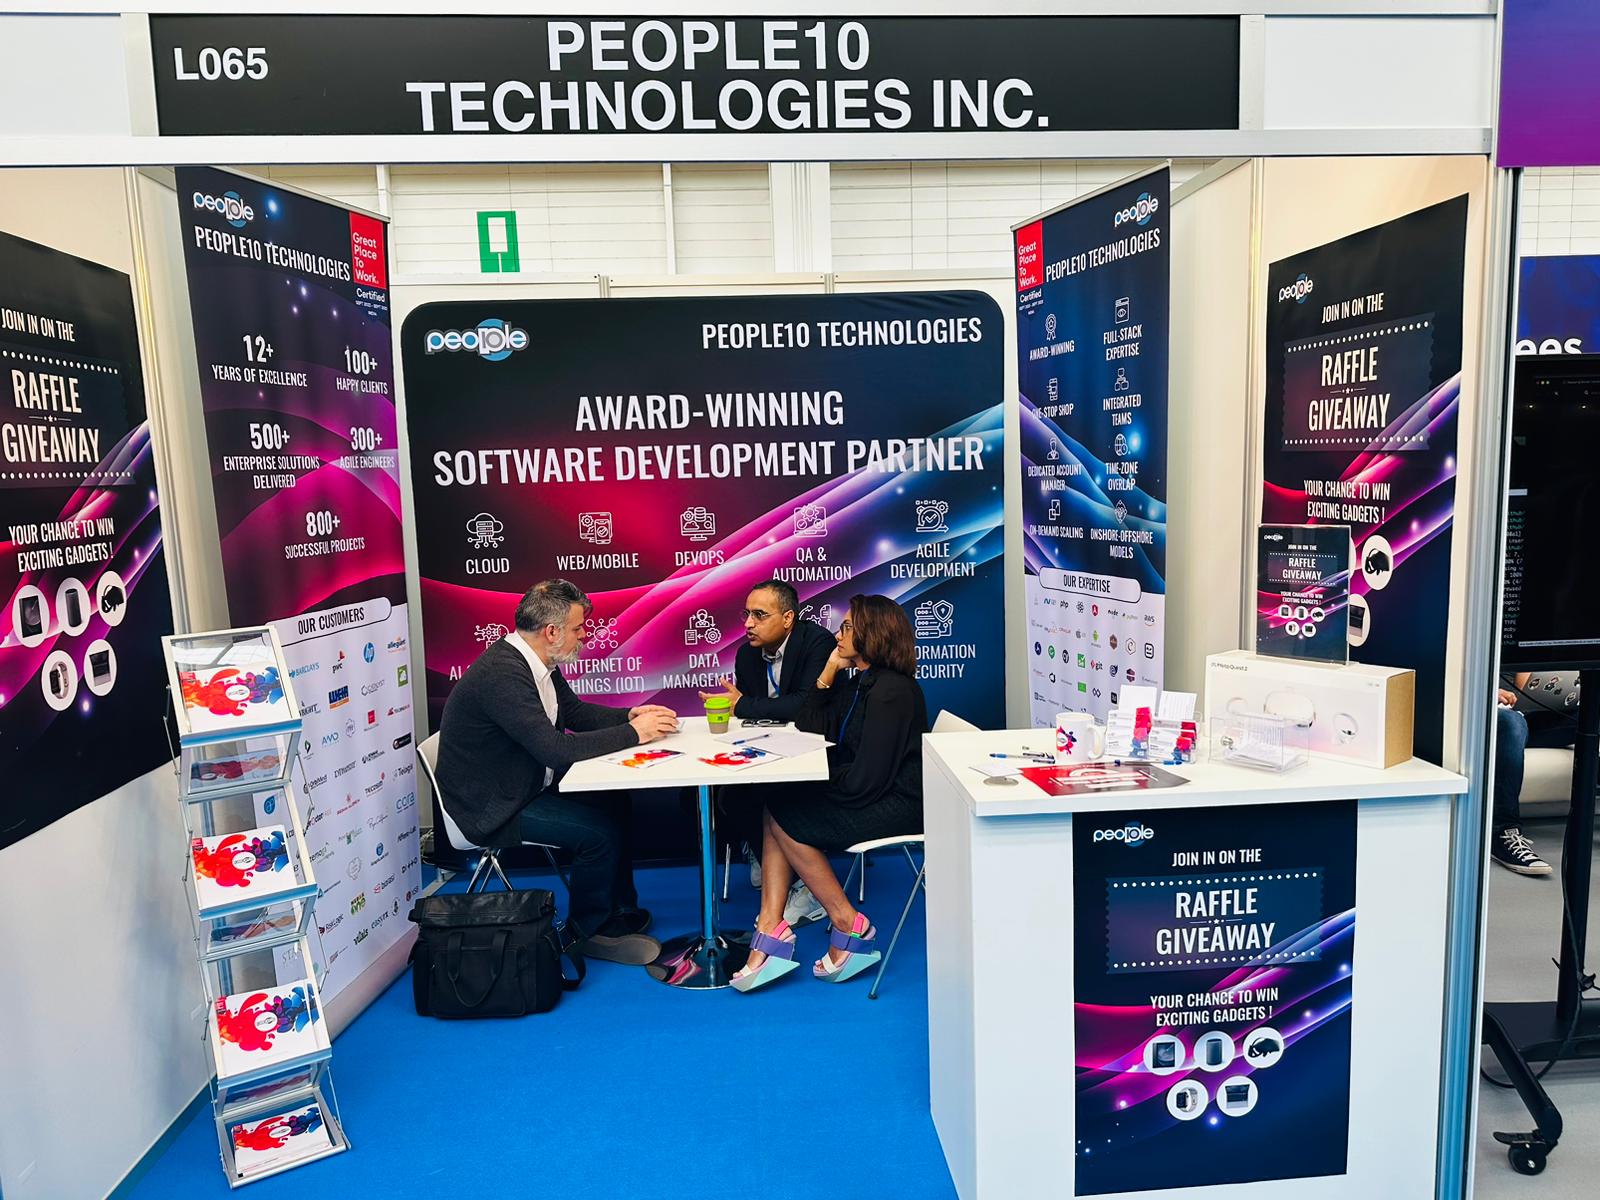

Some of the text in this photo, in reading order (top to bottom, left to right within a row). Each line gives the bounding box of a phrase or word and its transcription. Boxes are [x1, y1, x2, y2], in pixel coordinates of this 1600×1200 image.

[547, 19, 870, 71] PEOPLE10
[173, 47, 269, 81] L065
[405, 76, 1050, 131] TECHNOLOGIES INC.
[353, 232, 377, 249] Great
[1018, 241, 1037, 254] Great
[194, 225, 351, 282] PEOPLE10 TECHNOLOGIES
[354, 244, 377, 260] Place
[1019, 253, 1037, 266] Place
[1046, 228, 1161, 282] PEOPLE10 TECHNOLOGIES
[355, 256, 365, 270] To
[1019, 267, 1027, 277] To
[356, 288, 385, 303] Certified
[1321, 292, 1384, 324] JOIN IN ON THE
[1, 307, 76, 342] JOIN IN ON THE
[702, 317, 983, 350] PEOPLE10 TECHNOLOGIES
[1103, 324, 1142, 345] FULL-STACK
[243, 334, 274, 363] 12+
[1029, 340, 1075, 361] AWARD-WINNING
[1106, 342, 1140, 361] EXPERTISE
[345, 347, 378, 375] 100+
[1321, 346, 1378, 387] RAFFLE
[212, 364, 308, 387] YEARS OF EXCELLENCE
[11, 369, 82, 414] RAFFLE
[336, 377, 389, 395] HAPPY CLIENTS
[576, 391, 845, 431] AWARD-WINNING
[1058, 403, 1074, 416] SHOP
[1103, 394, 1142, 411] INTEGRATED
[1308, 393, 1390, 431] GIVEAWAY
[1111, 412, 1132, 427] TEAMS
[1, 423, 100, 463] GIVEAWAY
[250, 423, 291, 450] 500+
[350, 427, 383, 450] 300+
[223, 456, 320, 471] ENTERPRISE SOLUTIONS
[340, 456, 396, 469] AGILE ENGINEERS
[433, 437, 985, 487] SOFTWARE DEVELOPMENT PARTNER
[1027, 464, 1082, 478] DEDICATED ACCOUNT
[1105, 461, 1138, 475] TIME-ZONE
[253, 474, 296, 490] DELIVERED
[1040, 480, 1066, 491] MANAGER
[1107, 478, 1136, 491] OVERLAP
[1303, 479, 1390, 501] YOUR CHANCE TO WIN
[1307, 501, 1385, 525] EXCITING GADGETS !
[9, 517, 114, 546] YOUR CHANCE TO WIN
[306, 510, 341, 537] 800+
[1029, 524, 1084, 539] ON-DEMAND SCALING
[1090, 528, 1154, 545] ONSHORE-OFFSHORE
[18, 542, 114, 573] EXCITING GADGETS !
[285, 537, 365, 559] SUCCESSFUL PROJECTS
[796, 546, 827, 563] QA &
[916, 543, 950, 559] AGILE
[1110, 545, 1134, 559] MODELS
[465, 558, 511, 575] CLOUD
[556, 552, 640, 571] WEB/MOBILE
[675, 550, 725, 567] DEVOPS
[1288, 557, 1317, 568] RAFFLE
[773, 565, 852, 583] AUTOMATION
[891, 561, 977, 579] DEVELOPMENT
[1282, 569, 1322, 581] GIVEAWAY
[1063, 573, 1111, 593] OUR EXPERTISE
[298, 607, 365, 635] OUR CUSTOMERS
[688, 652, 721, 669] DATA
[914, 644, 976, 660] ORMATION
[296, 662, 320, 676] BARCLAYS
[449, 665, 462, 681] AI
[565, 656, 643, 675] INTERNET OF
[914, 663, 965, 680] ECURITY
[615, 675, 645, 695] (IOT)
[663, 671, 738, 690] MANAGEMEN
[1172, 848, 1262, 867] JOIN IN ON THE
[1175, 887, 1258, 919] RAFFLE
[1156, 921, 1276, 955] GIVEAWAY
[1150, 987, 1279, 1010] YOUR CHANCE TO WIN
[1156, 1006, 1273, 1027] EXCITING GADGETS !
